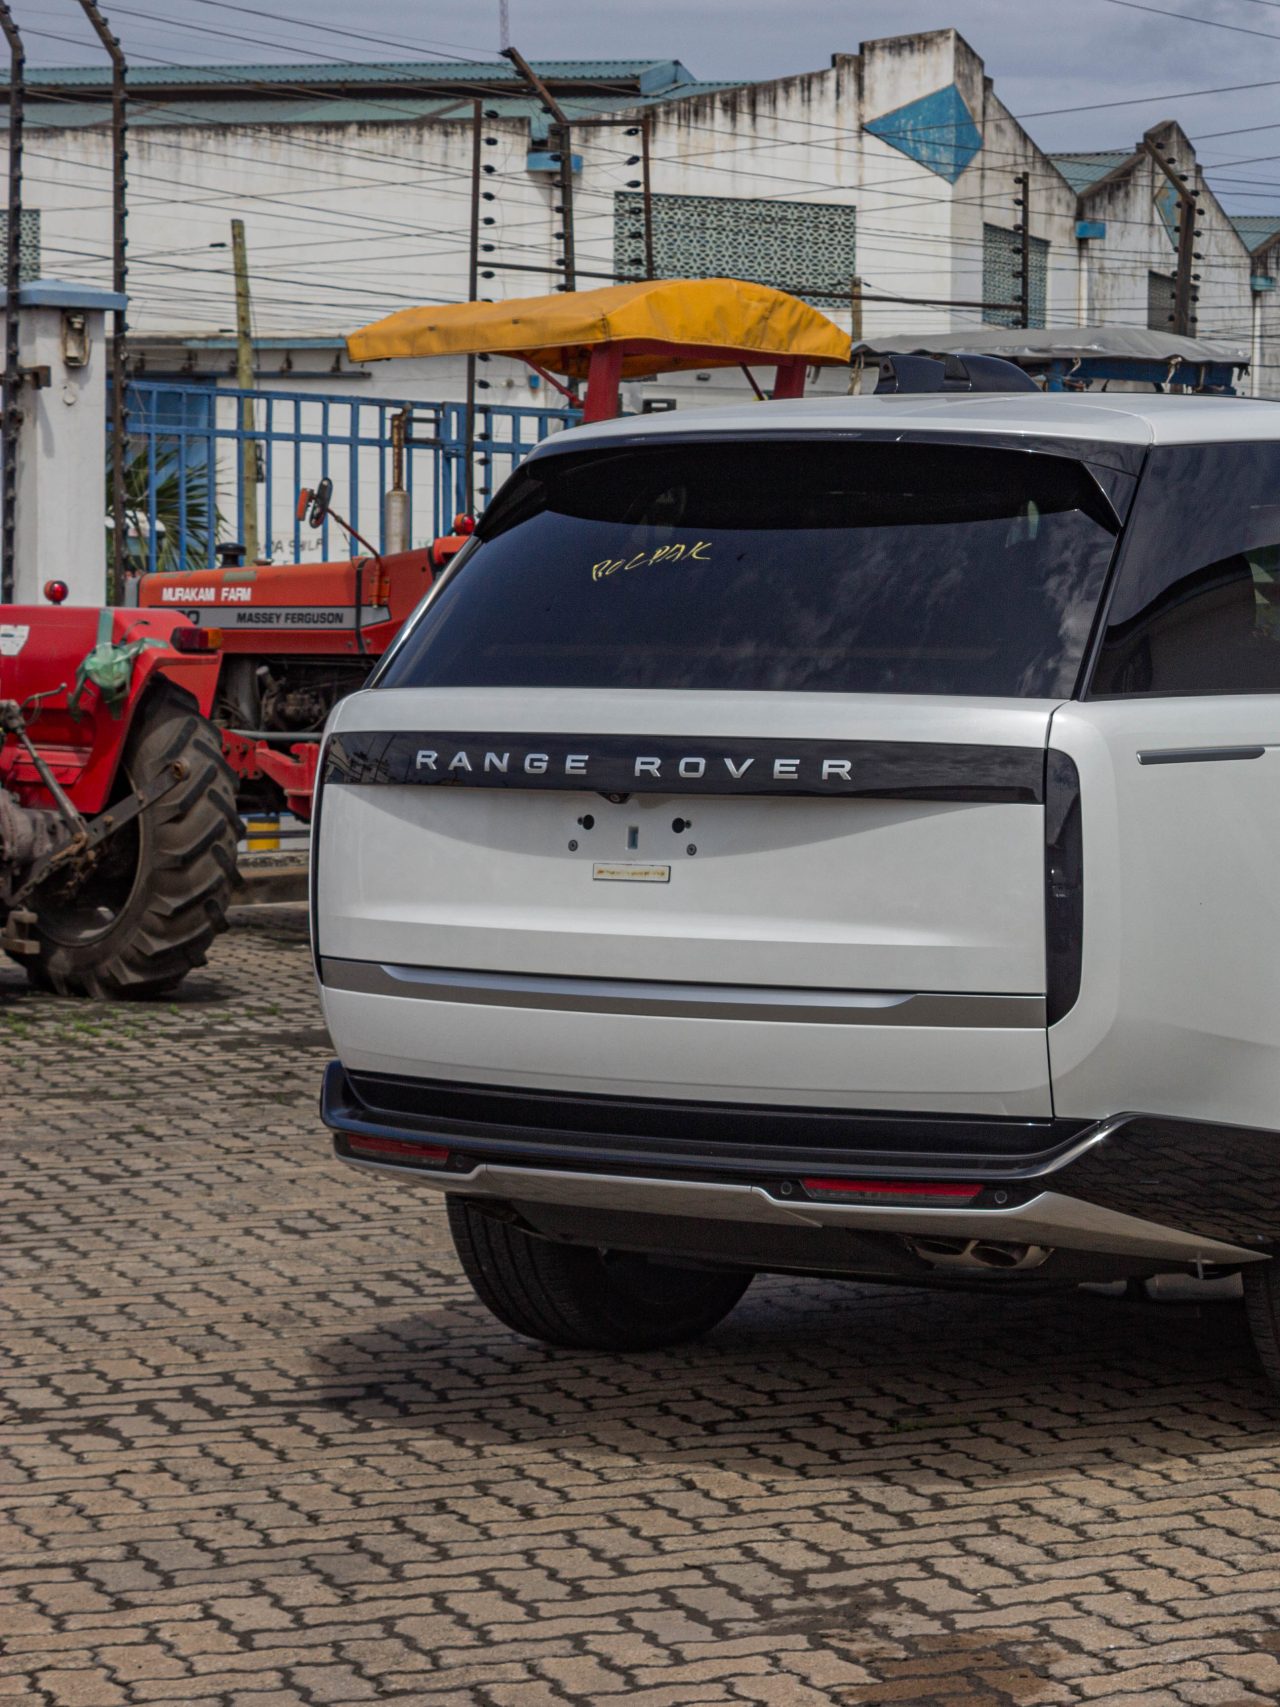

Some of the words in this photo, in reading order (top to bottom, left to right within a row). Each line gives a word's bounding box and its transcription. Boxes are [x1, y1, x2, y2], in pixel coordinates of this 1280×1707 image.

[221, 587, 252, 602] FARM
[236, 612, 282, 624] MASSEY
[284, 612, 344, 624] FERGUSON
[415, 749, 590, 775] RANGE
[634, 756, 852, 781] ROVER
